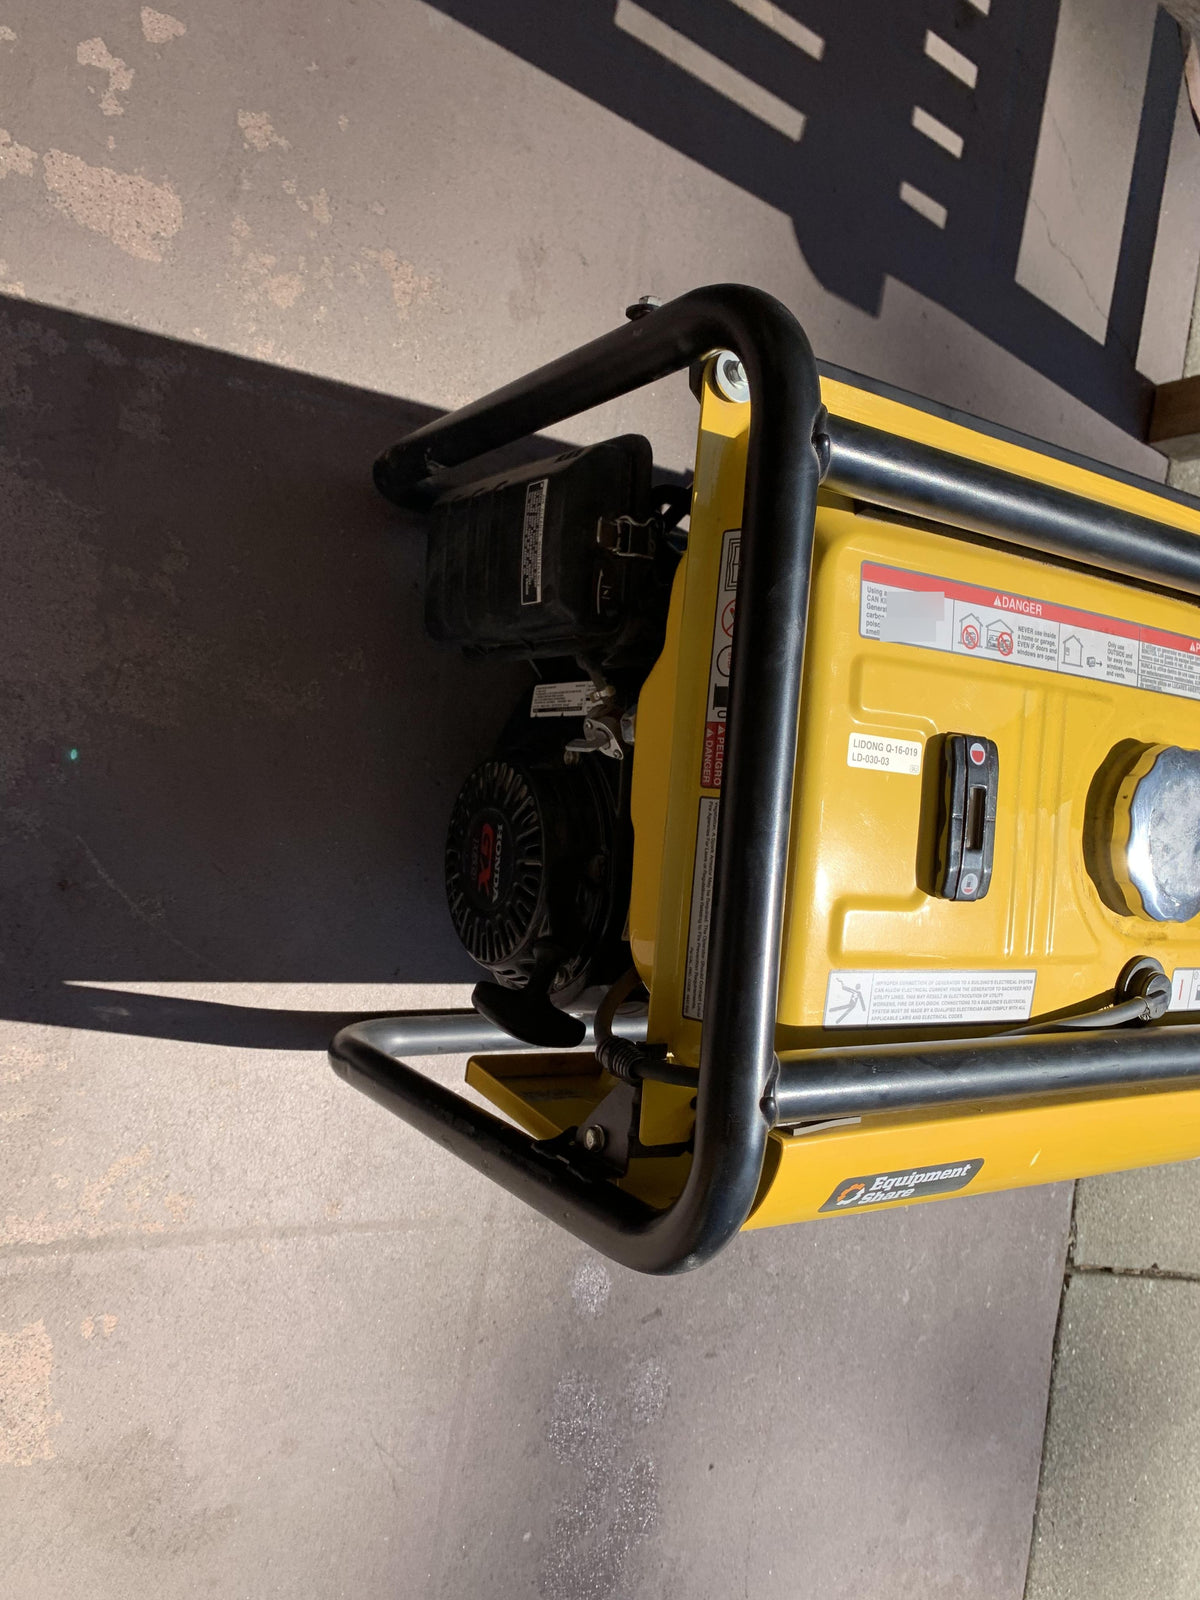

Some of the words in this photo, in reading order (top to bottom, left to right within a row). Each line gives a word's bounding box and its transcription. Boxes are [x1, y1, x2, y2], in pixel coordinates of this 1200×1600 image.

[867, 586, 883, 597] Using
[867, 595, 879, 603] CAN
[1002, 596, 1042, 615] DANGER
[1018, 626, 1034, 635] NEVER
[1044, 631, 1056, 639] inside
[1022, 634, 1034, 642] home
[1018, 641, 1030, 649] EVEN
[1036, 645, 1048, 653] doors
[1049, 646, 1057, 654] and
[1108, 641, 1116, 651] Only
[1017, 650, 1036, 658] windows
[853, 739, 884, 752] LIDONG
[886, 744, 918, 757] Q-16-019
[704, 741, 713, 783] DANGER
[714, 737, 725, 786] PELIGRO
[852, 752, 890, 766] LD-030-03
[492, 824, 502, 903] HONDA
[869, 1164, 972, 1192] Equipment
[858, 1188, 916, 1205] Share
